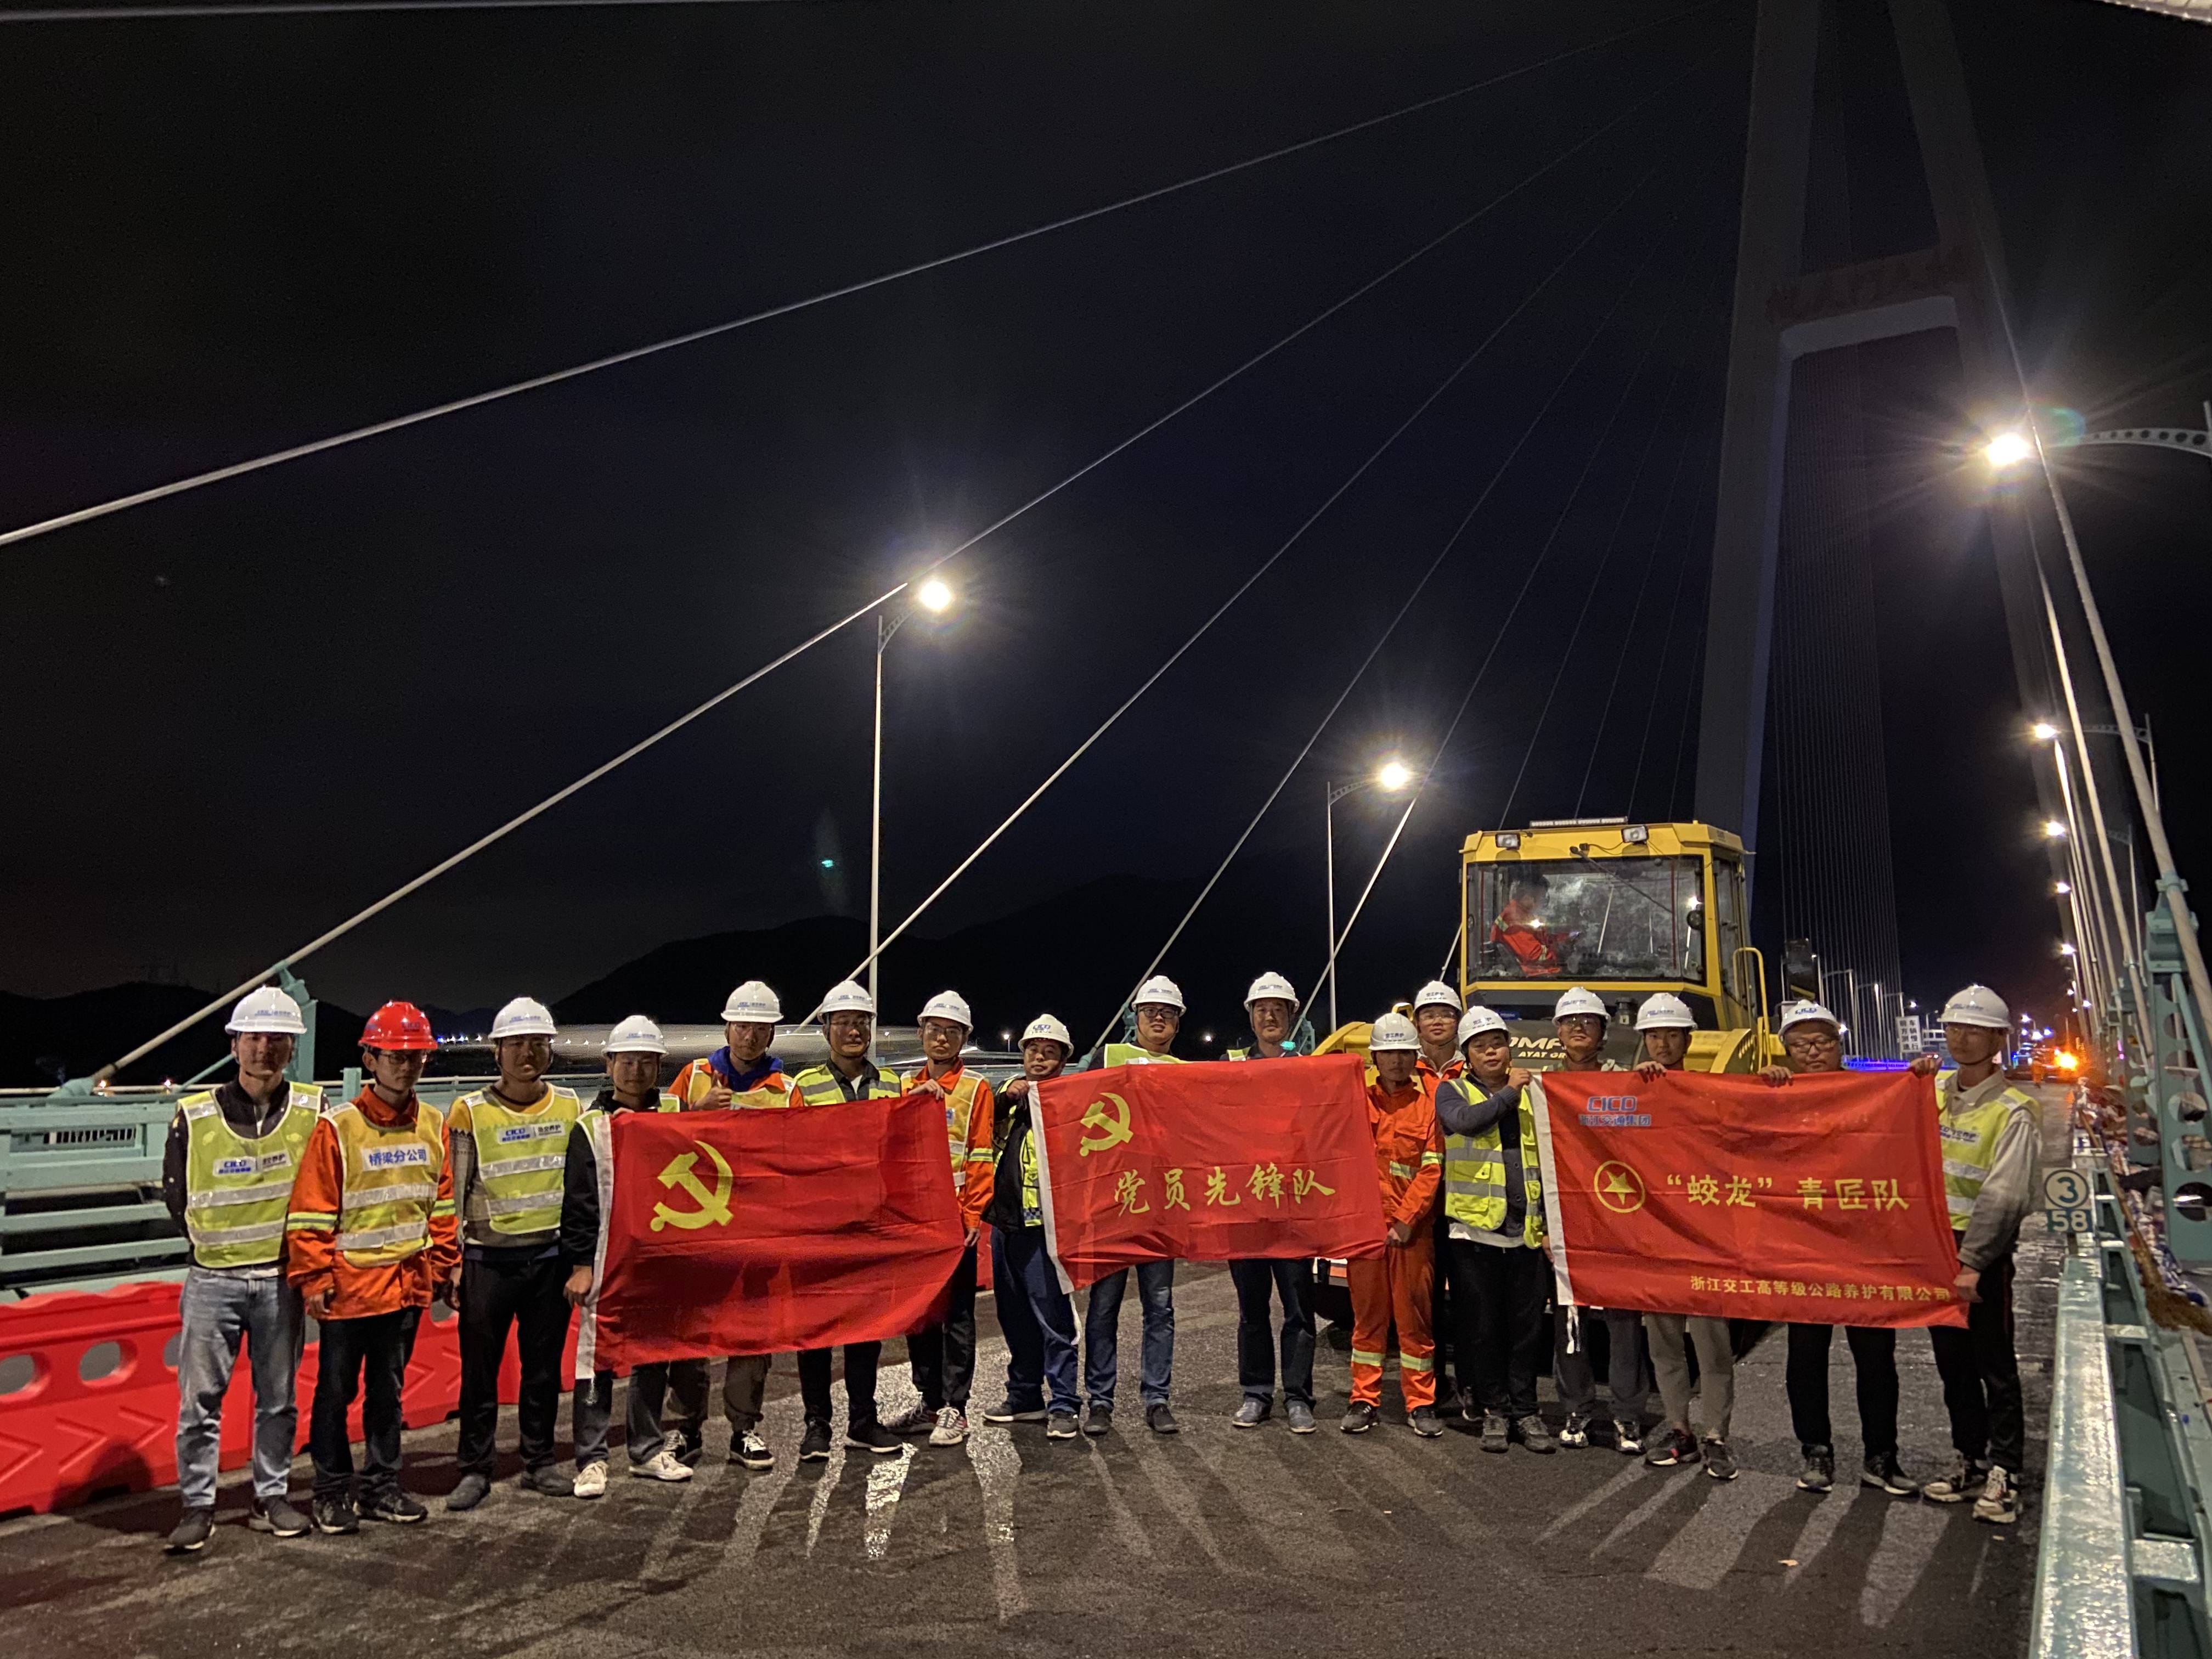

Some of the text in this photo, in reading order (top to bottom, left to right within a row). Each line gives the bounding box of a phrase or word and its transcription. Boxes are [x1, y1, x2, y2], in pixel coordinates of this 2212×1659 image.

[1587, 1096, 1637, 1112] CICO
[1578, 1114, 1651, 1126] 浙江交通集团
[369, 1149, 426, 1166] 桥梁分公司
[1115, 1162, 1335, 1217] 党员先锋队
[2057, 1176, 2078, 1203] 3
[2052, 1210, 2088, 1232] 58
[1690, 1276, 1950, 1302] 浙江交工高等级公路养护有限公司
